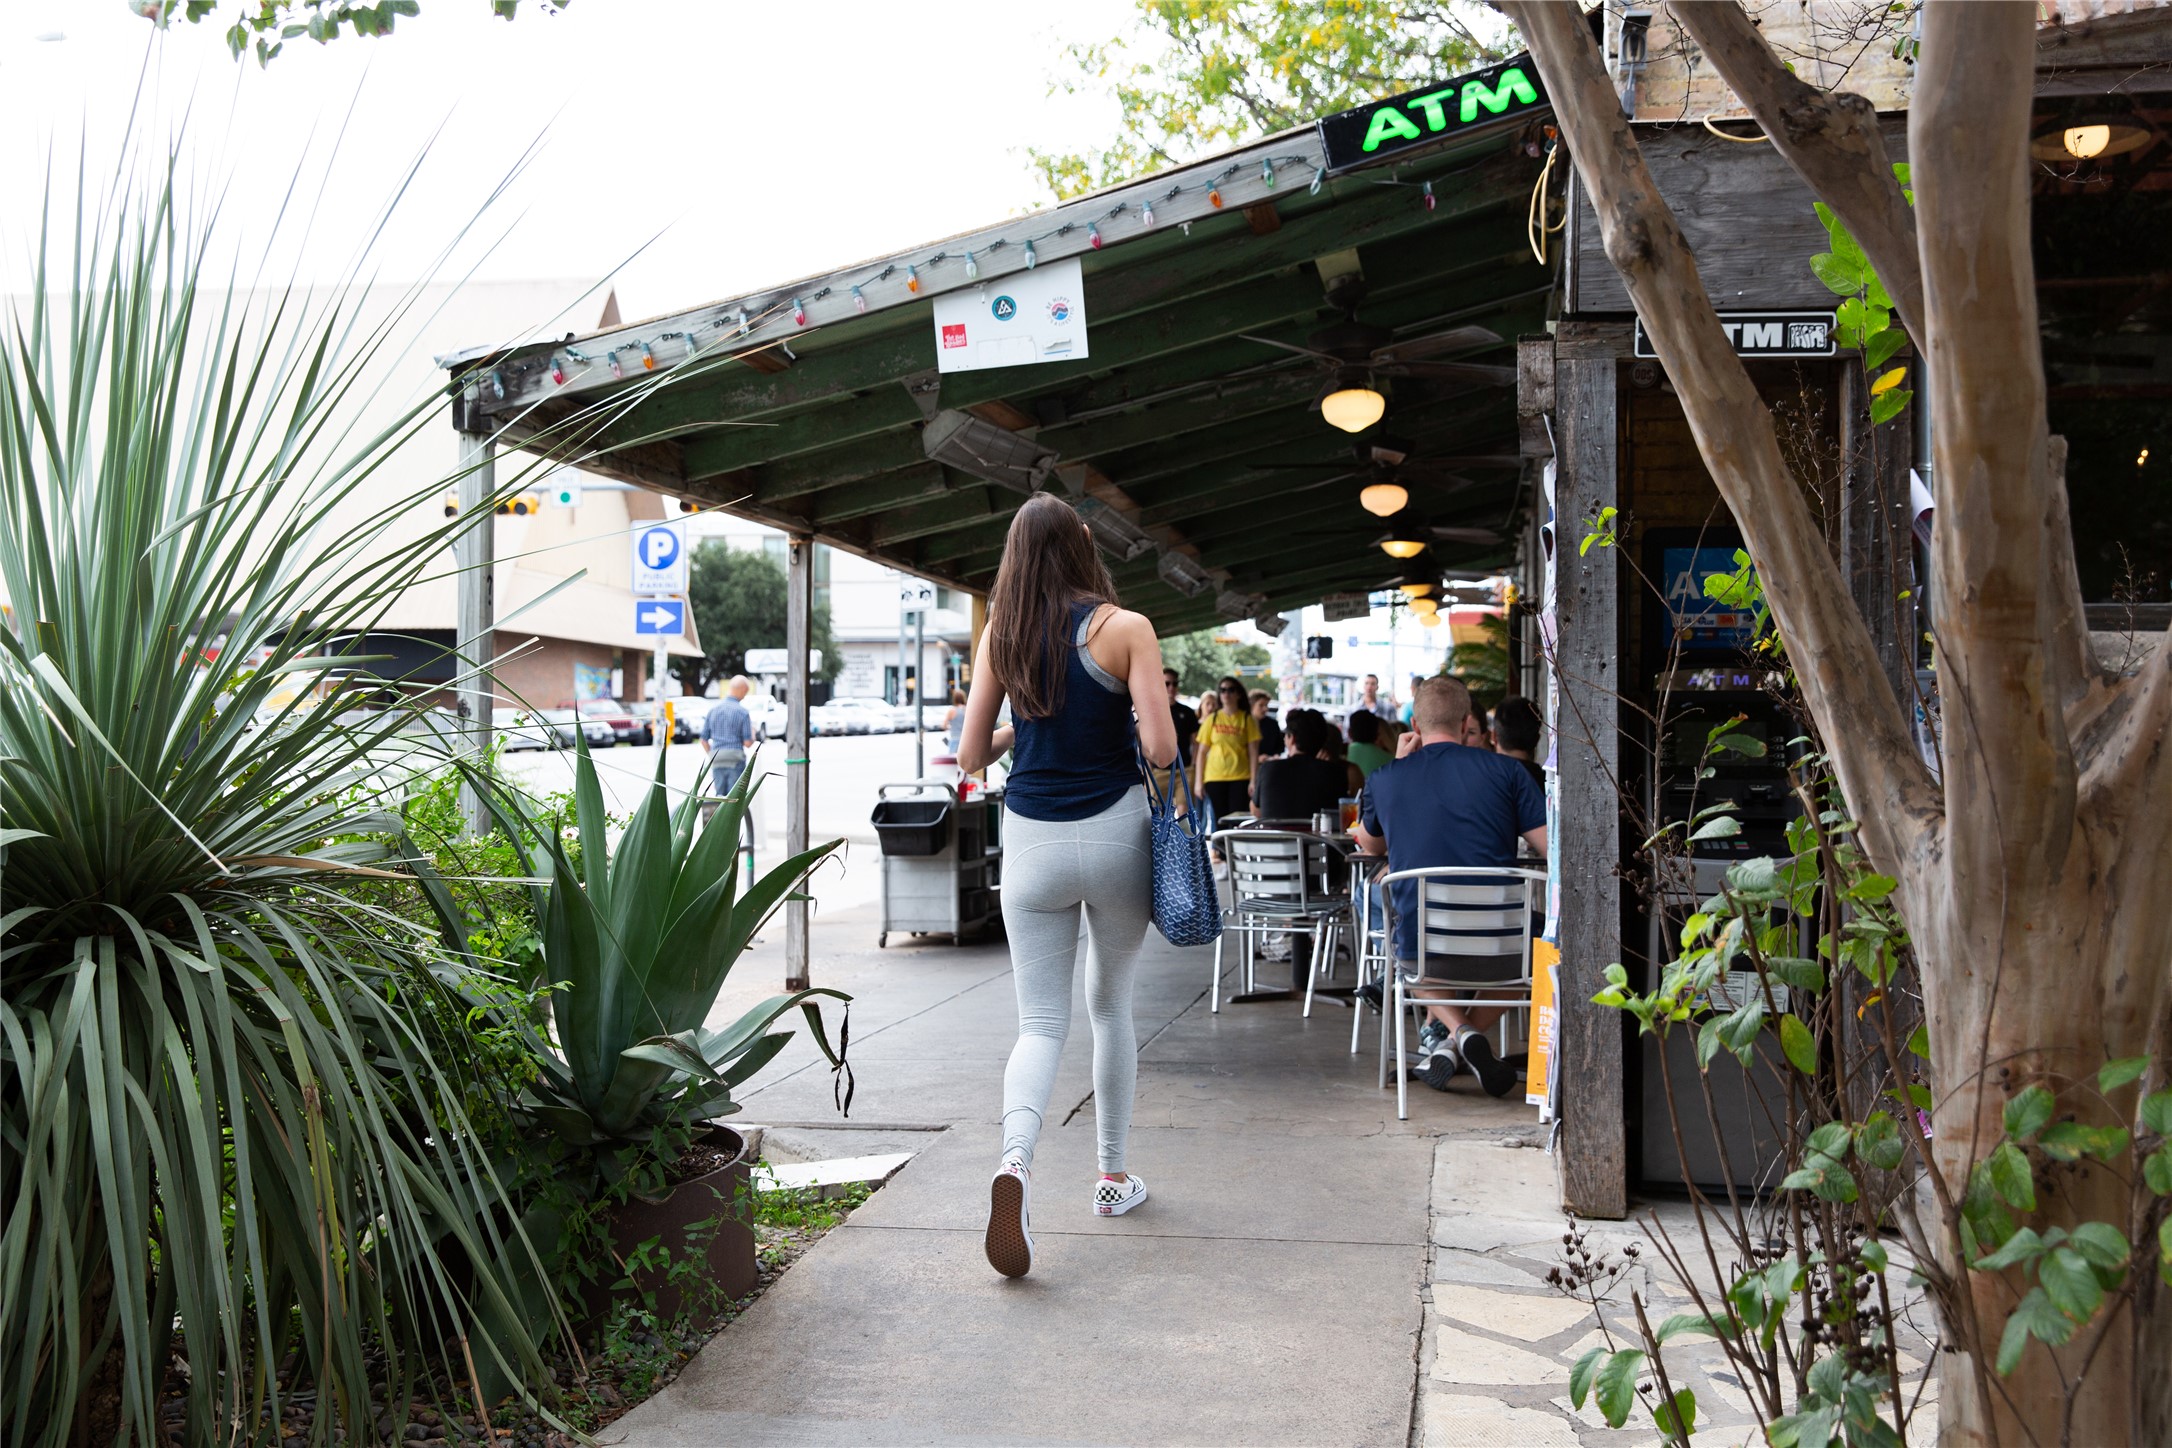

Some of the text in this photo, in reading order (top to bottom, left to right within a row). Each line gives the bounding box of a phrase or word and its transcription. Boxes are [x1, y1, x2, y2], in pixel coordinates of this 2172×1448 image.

[1362, 68, 1538, 152] ATM
[1052, 295, 1071, 304] HIPPY
[1721, 322, 1784, 348] TM
[647, 532, 674, 567] P
